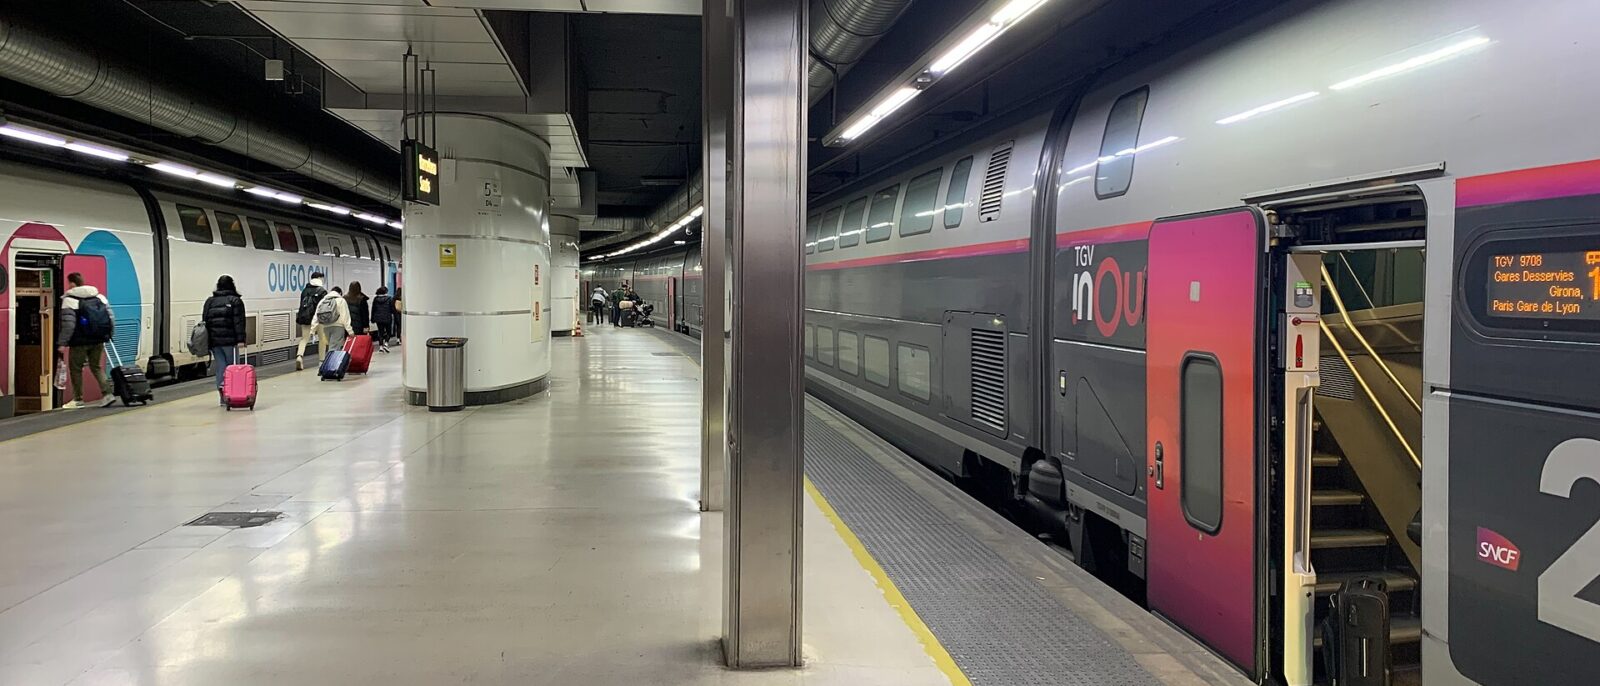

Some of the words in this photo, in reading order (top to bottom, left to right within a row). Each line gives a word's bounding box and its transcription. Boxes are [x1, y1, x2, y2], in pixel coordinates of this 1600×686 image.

[1074, 244, 1095, 267] TGV
[1494, 256, 1514, 267] TGV
[1520, 255, 1542, 267] 9708
[1494, 271, 1520, 282] Gares
[1522, 269, 1575, 282] Desservies
[1549, 285, 1584, 300] Girona,
[1493, 299, 1515, 312] Paris
[1516, 300, 1539, 312] Gare
[1541, 300, 1553, 313] de
[1556, 301, 1580, 315] Lyon
[1478, 541, 1518, 565] SNCF
